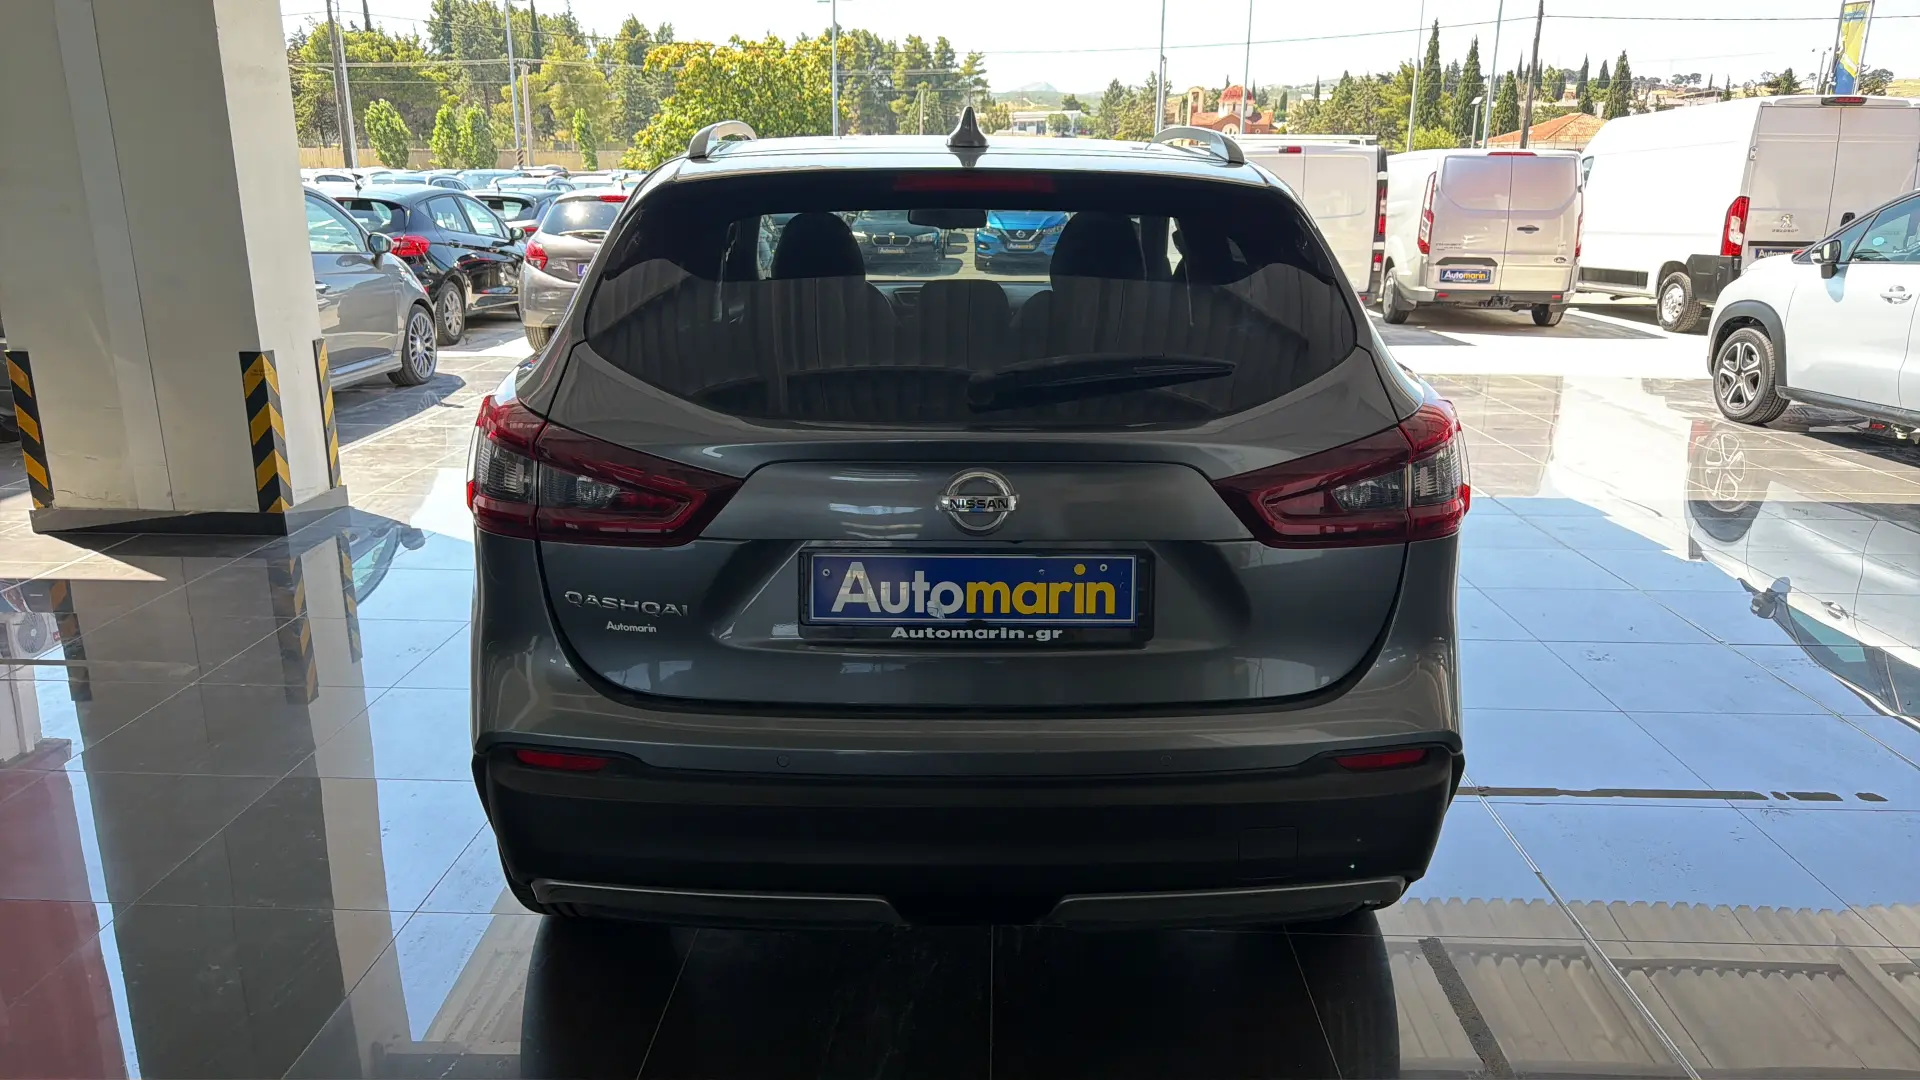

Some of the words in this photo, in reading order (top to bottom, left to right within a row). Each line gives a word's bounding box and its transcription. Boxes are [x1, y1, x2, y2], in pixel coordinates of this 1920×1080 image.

[1444, 270, 1486, 279] Automarin
[949, 499, 1009, 509] NISSAN
[831, 561, 1117, 615] Automarin
[564, 590, 688, 618] QASHQAI
[606, 620, 657, 633] Automarin
[891, 626, 1063, 641] Automarin.gr
